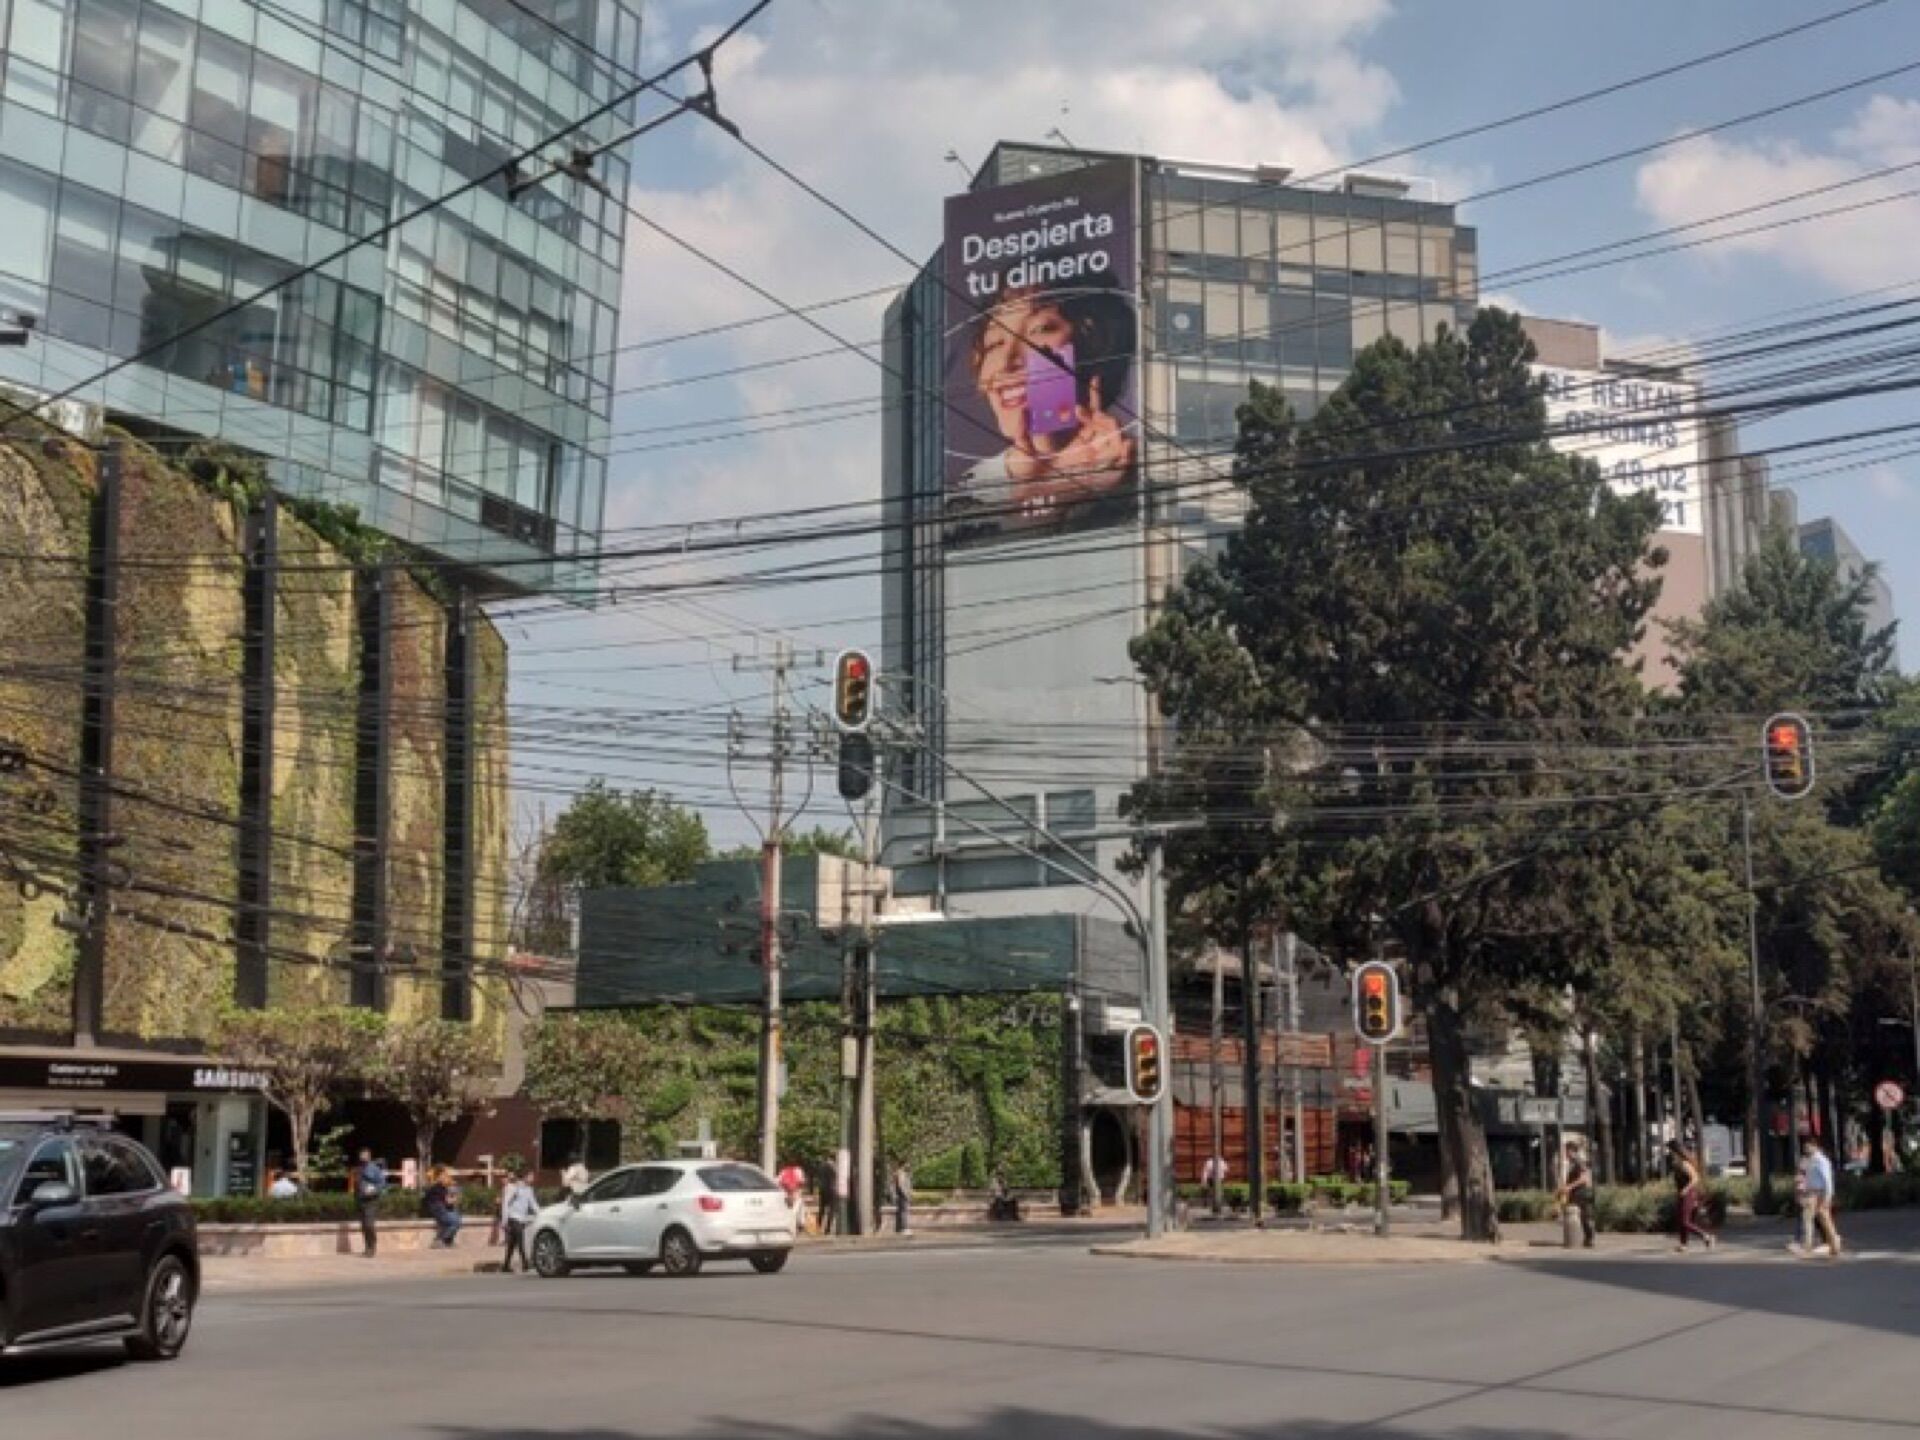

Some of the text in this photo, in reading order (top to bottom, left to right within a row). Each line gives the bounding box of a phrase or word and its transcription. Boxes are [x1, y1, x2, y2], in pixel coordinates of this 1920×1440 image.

[963, 212, 1114, 266] Despierta
[967, 250, 1109, 297] tu dinero
